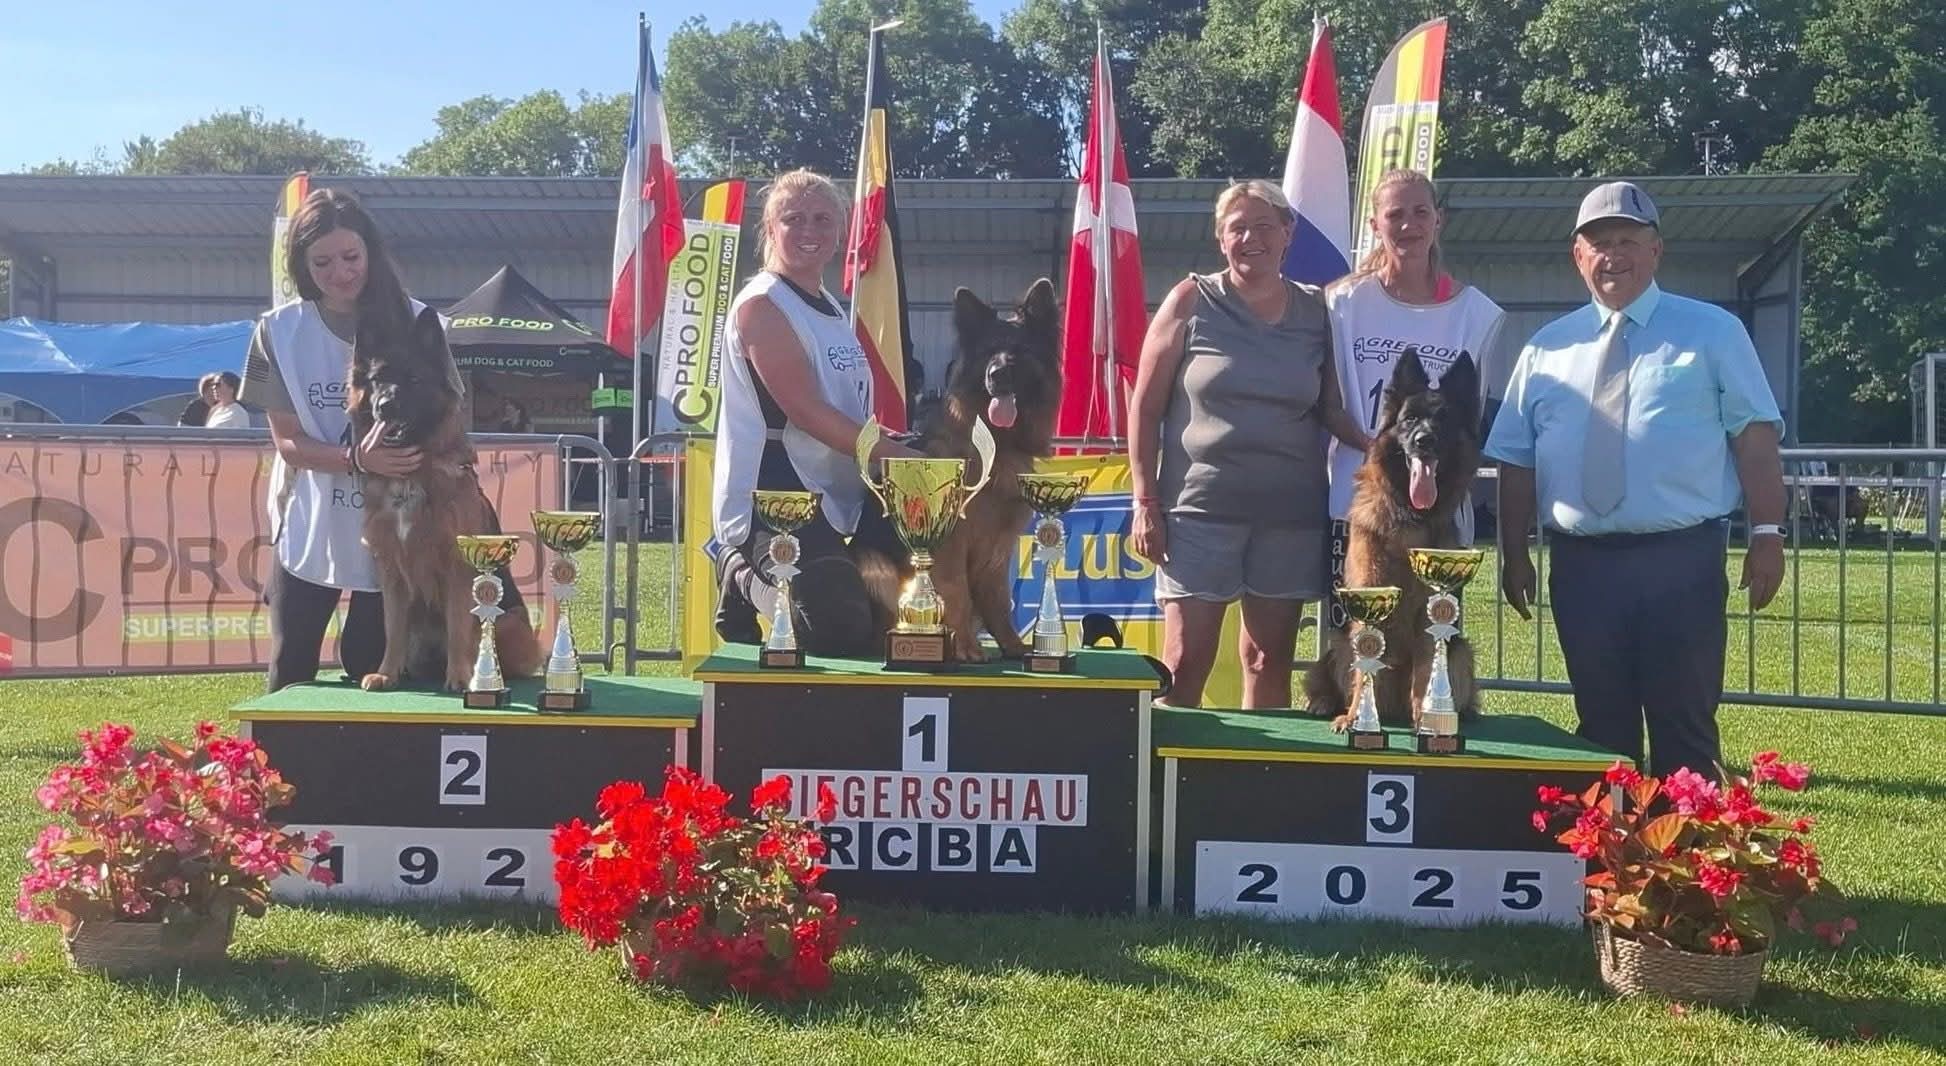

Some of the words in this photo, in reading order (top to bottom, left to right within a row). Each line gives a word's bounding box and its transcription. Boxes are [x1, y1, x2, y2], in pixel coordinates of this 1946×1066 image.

[1416, 125, 1430, 171] FOOD
[722, 237, 733, 265] FOOD
[683, 233, 710, 316] FOOD
[720, 265, 730, 284] CAT
[720, 284, 728, 292] &
[452, 317, 494, 328] PRO
[498, 318, 554, 331] FOOD
[717, 293, 727, 313] DOG
[675, 325, 700, 385] PRO
[711, 315, 725, 357] PREMIUM
[474, 357, 495, 366] DOG
[506, 358, 523, 367] CAT
[526, 359, 554, 368] FOOD
[707, 358, 720, 387] SUPER
[1423, 360, 1449, 373] TRUC
[0, 497, 105, 642] C
[908, 714, 937, 762] 1
[443, 749, 482, 796] 2
[1369, 780, 1410, 834] 3
[1236, 863, 1543, 911] 2025
